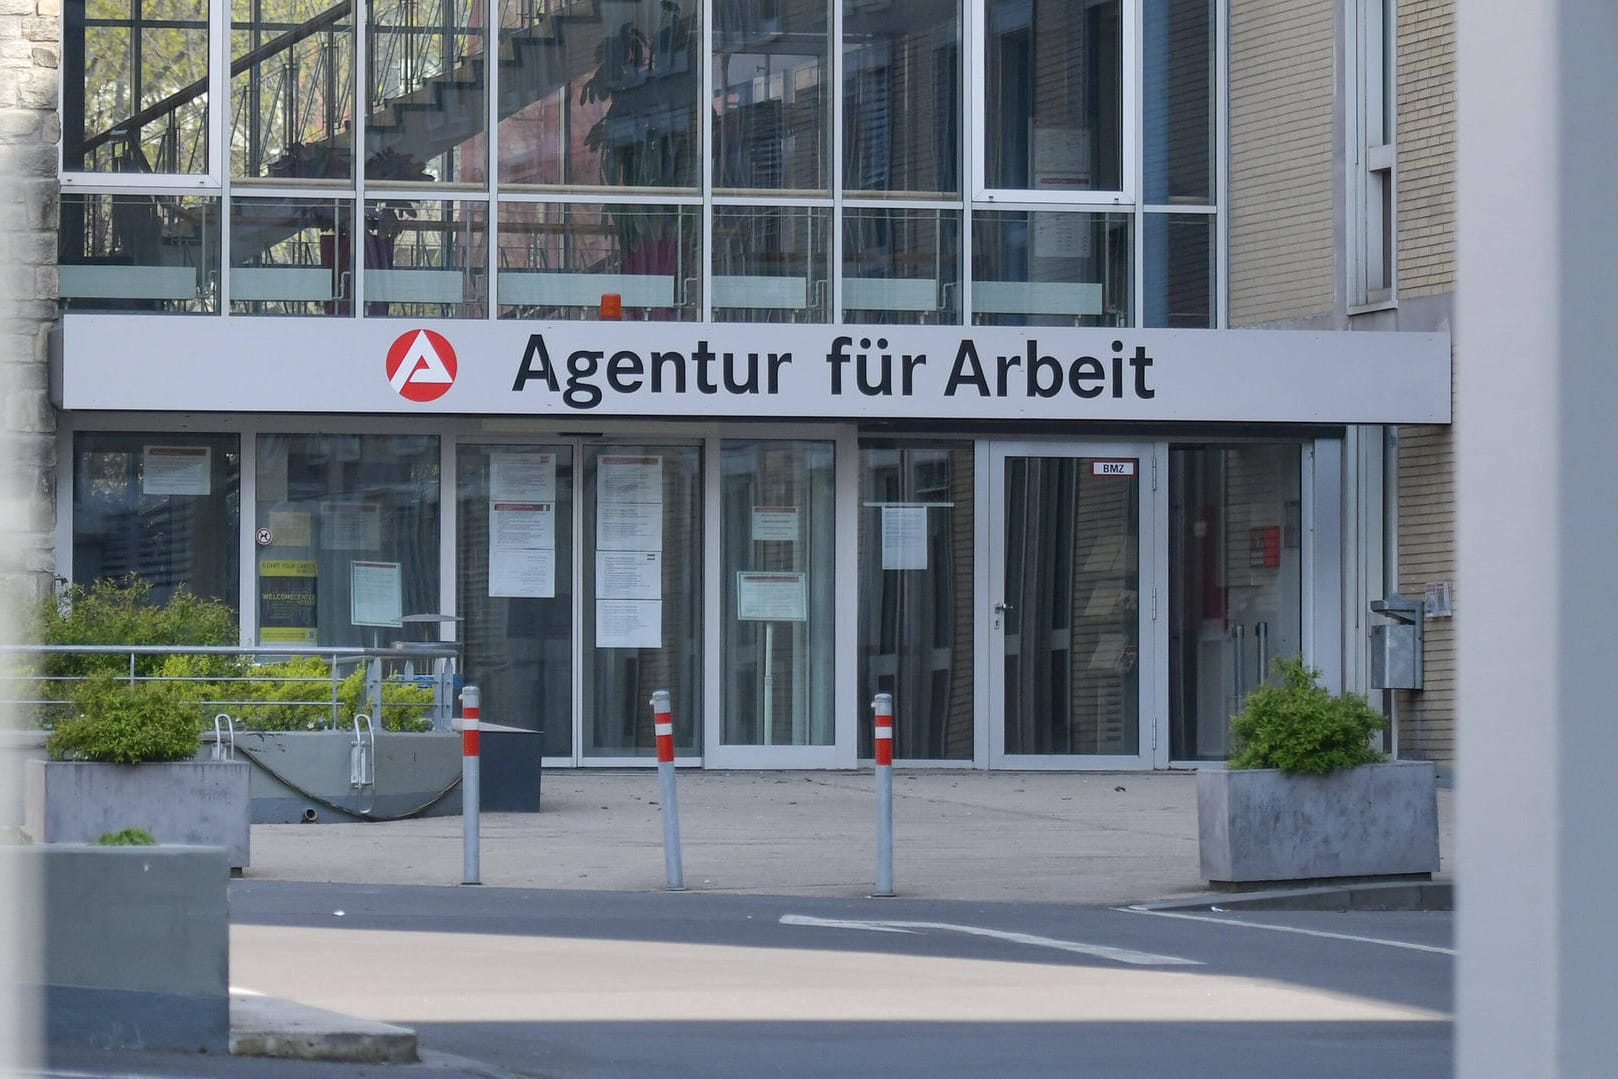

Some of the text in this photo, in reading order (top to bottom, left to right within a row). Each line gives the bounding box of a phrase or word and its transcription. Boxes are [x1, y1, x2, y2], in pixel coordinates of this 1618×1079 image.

[512, 333, 1156, 410] Agentur für Arbeit
[1103, 464, 1125, 473] BMZ
